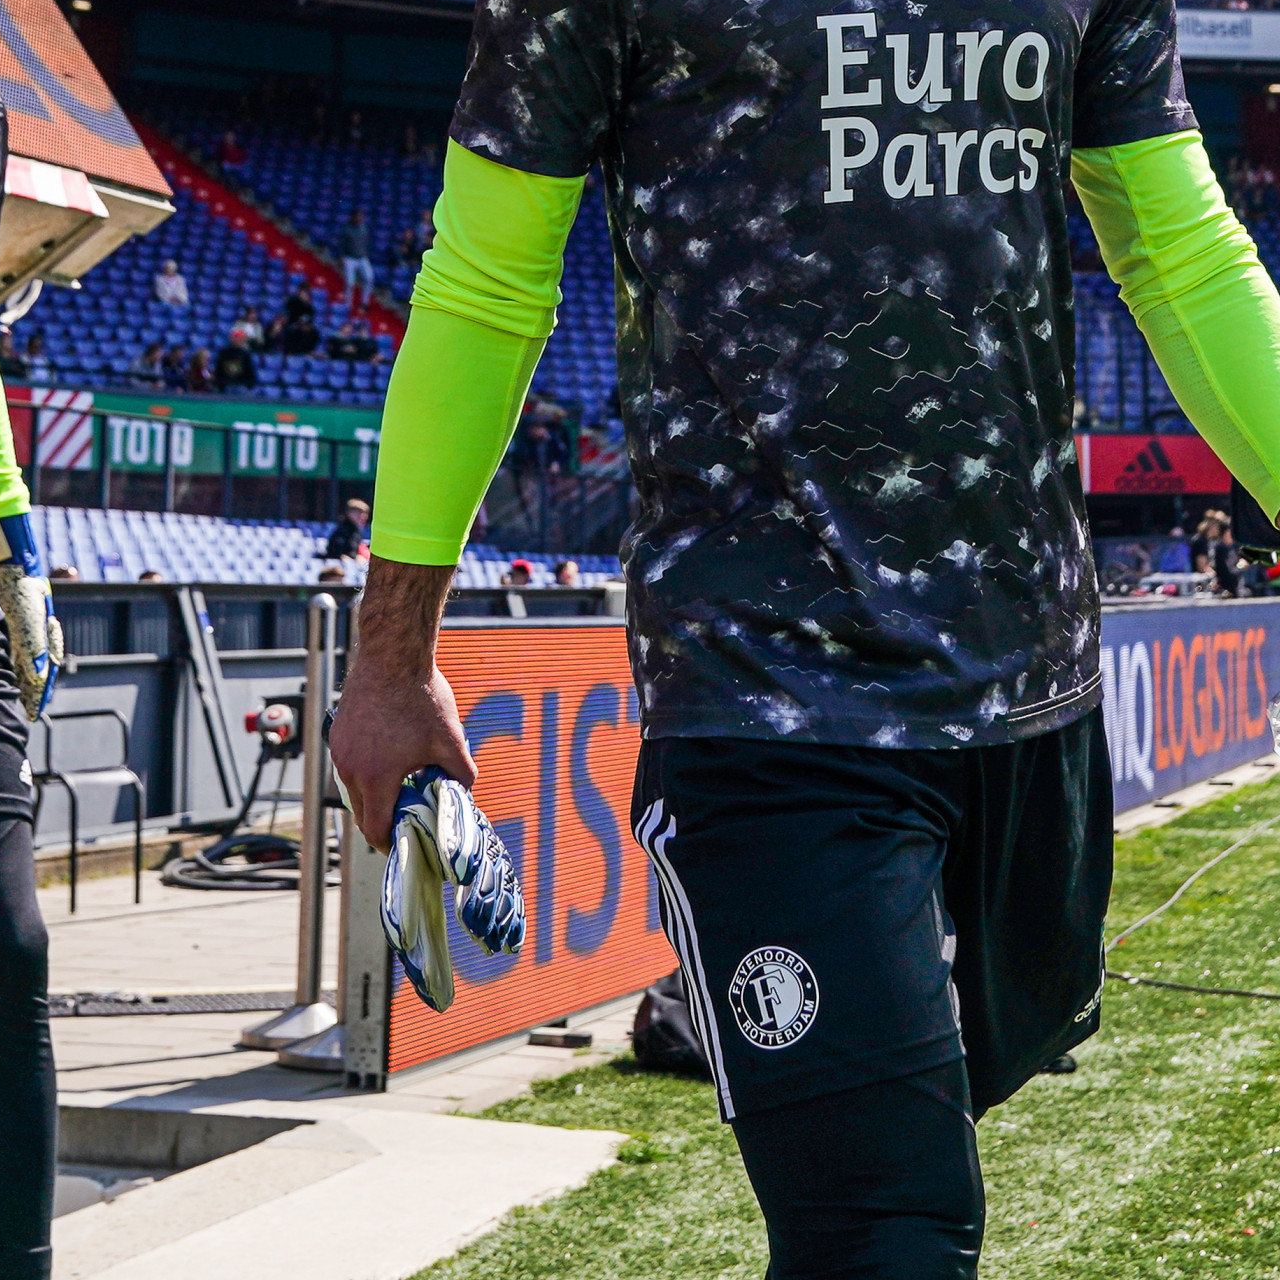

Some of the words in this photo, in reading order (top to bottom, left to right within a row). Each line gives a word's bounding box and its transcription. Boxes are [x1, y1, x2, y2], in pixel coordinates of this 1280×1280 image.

[816, 12, 1050, 111] Euro
[821, 116, 1046, 204] Parcs
[109, 416, 194, 466] TOTO
[233, 421, 320, 470] TOTO
[1154, 627, 1267, 771] LOGISTICS
[732, 950, 804, 995] FEYENOORD
[742, 999, 815, 1045] ROTTERDAM
